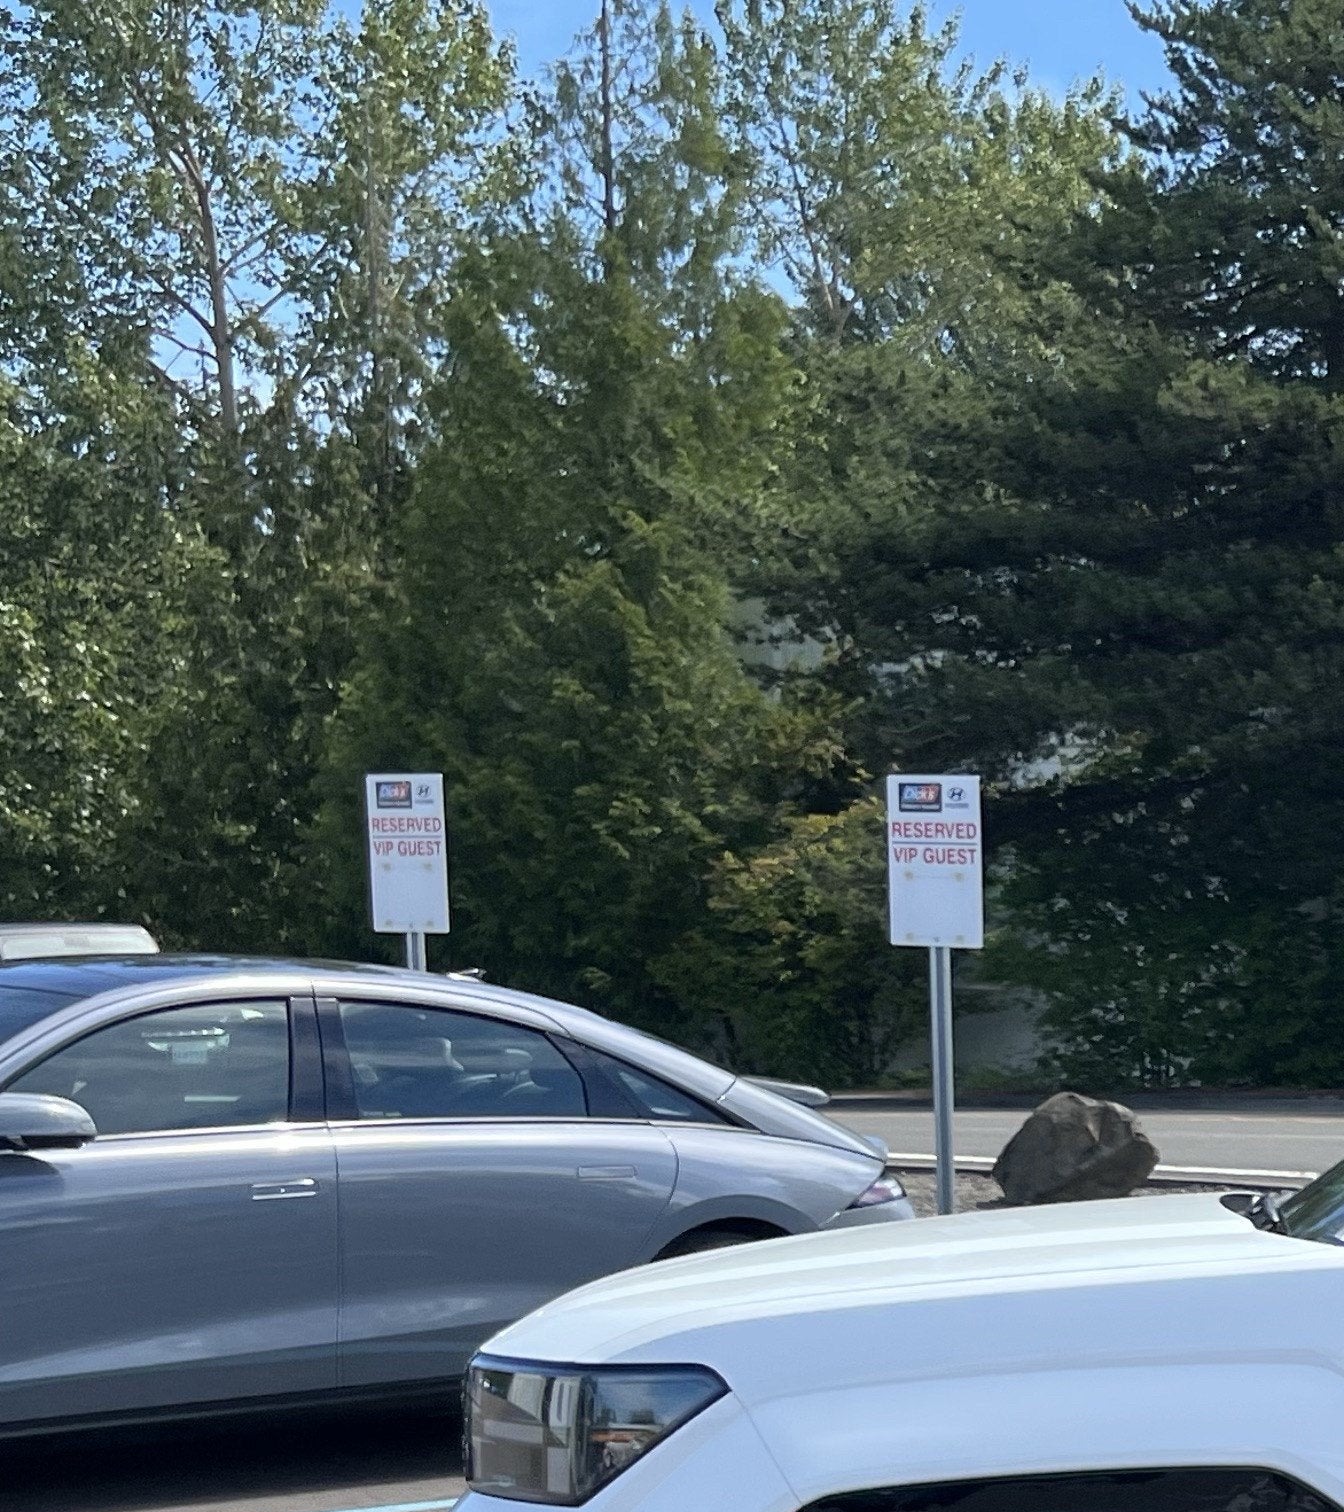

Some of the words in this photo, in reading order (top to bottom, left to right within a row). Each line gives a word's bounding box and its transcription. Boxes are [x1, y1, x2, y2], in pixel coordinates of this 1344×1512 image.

[371, 817, 442, 833] RESERVED
[892, 822, 978, 840] RESERVED
[373, 840, 394, 856] VIP
[397, 840, 442, 857] GUEST
[893, 847, 918, 864] VIP
[923, 848, 977, 865] GUEST
